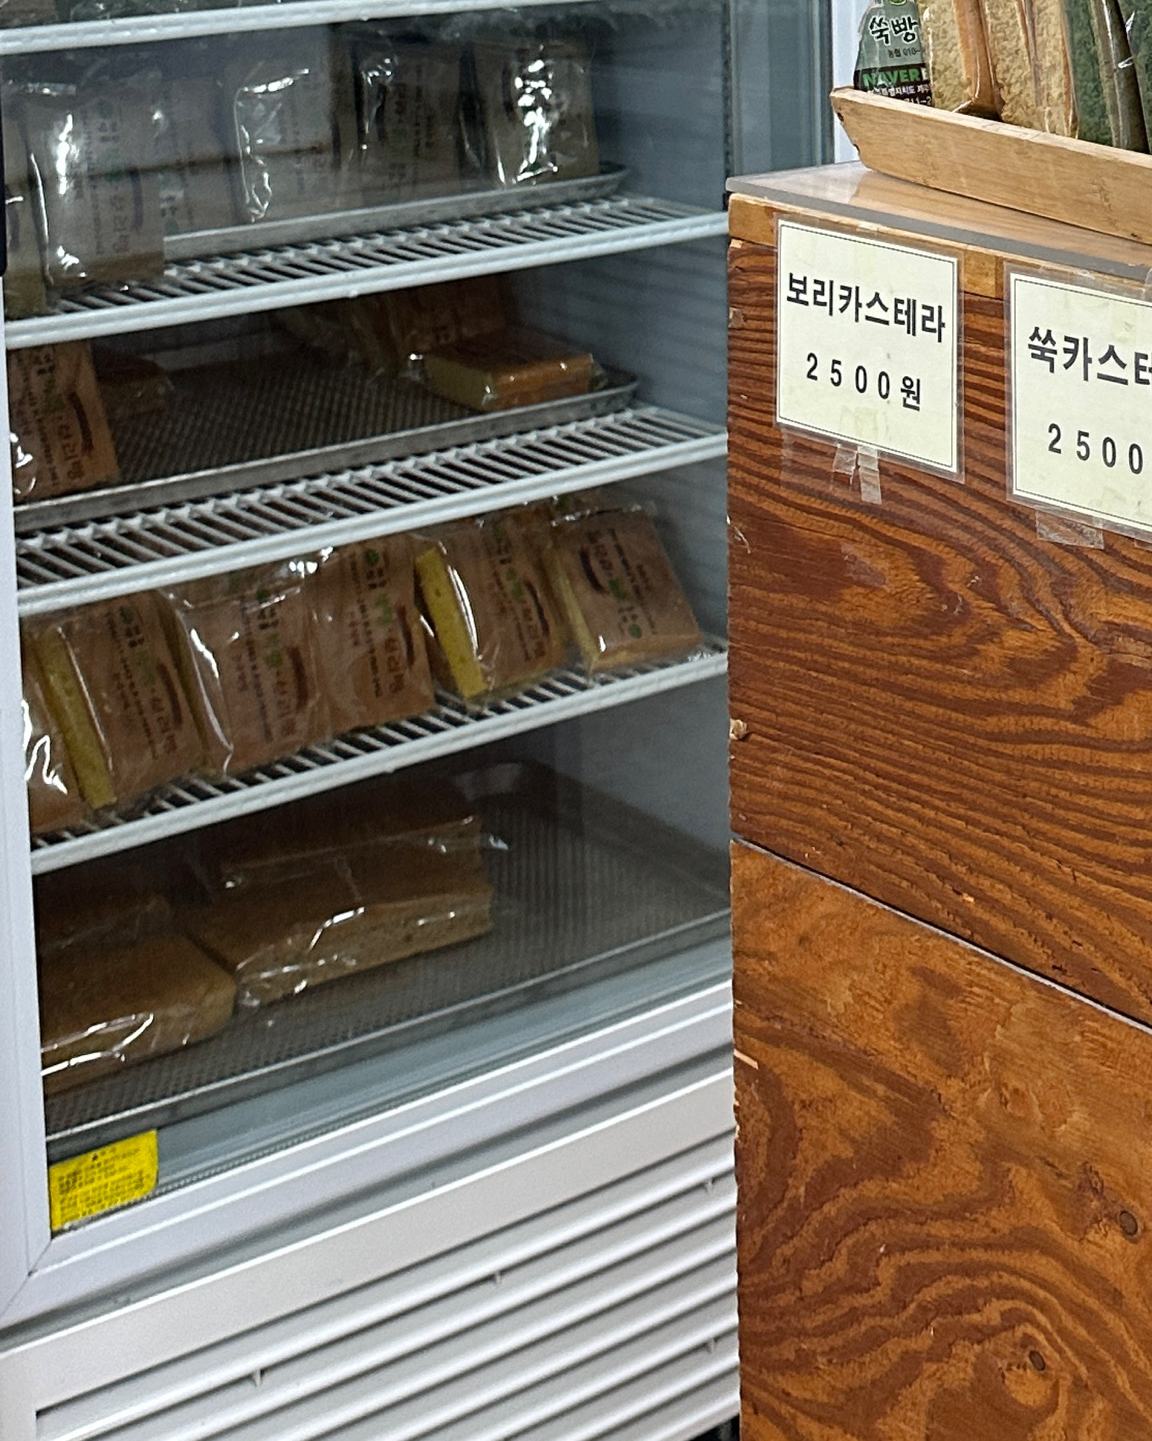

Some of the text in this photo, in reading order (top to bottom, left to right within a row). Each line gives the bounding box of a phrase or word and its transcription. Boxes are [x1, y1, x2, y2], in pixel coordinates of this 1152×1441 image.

[868, 14, 919, 45] 쑥빵
[862, 67, 921, 90] NAVER
[786, 272, 947, 343] 보리카스테라
